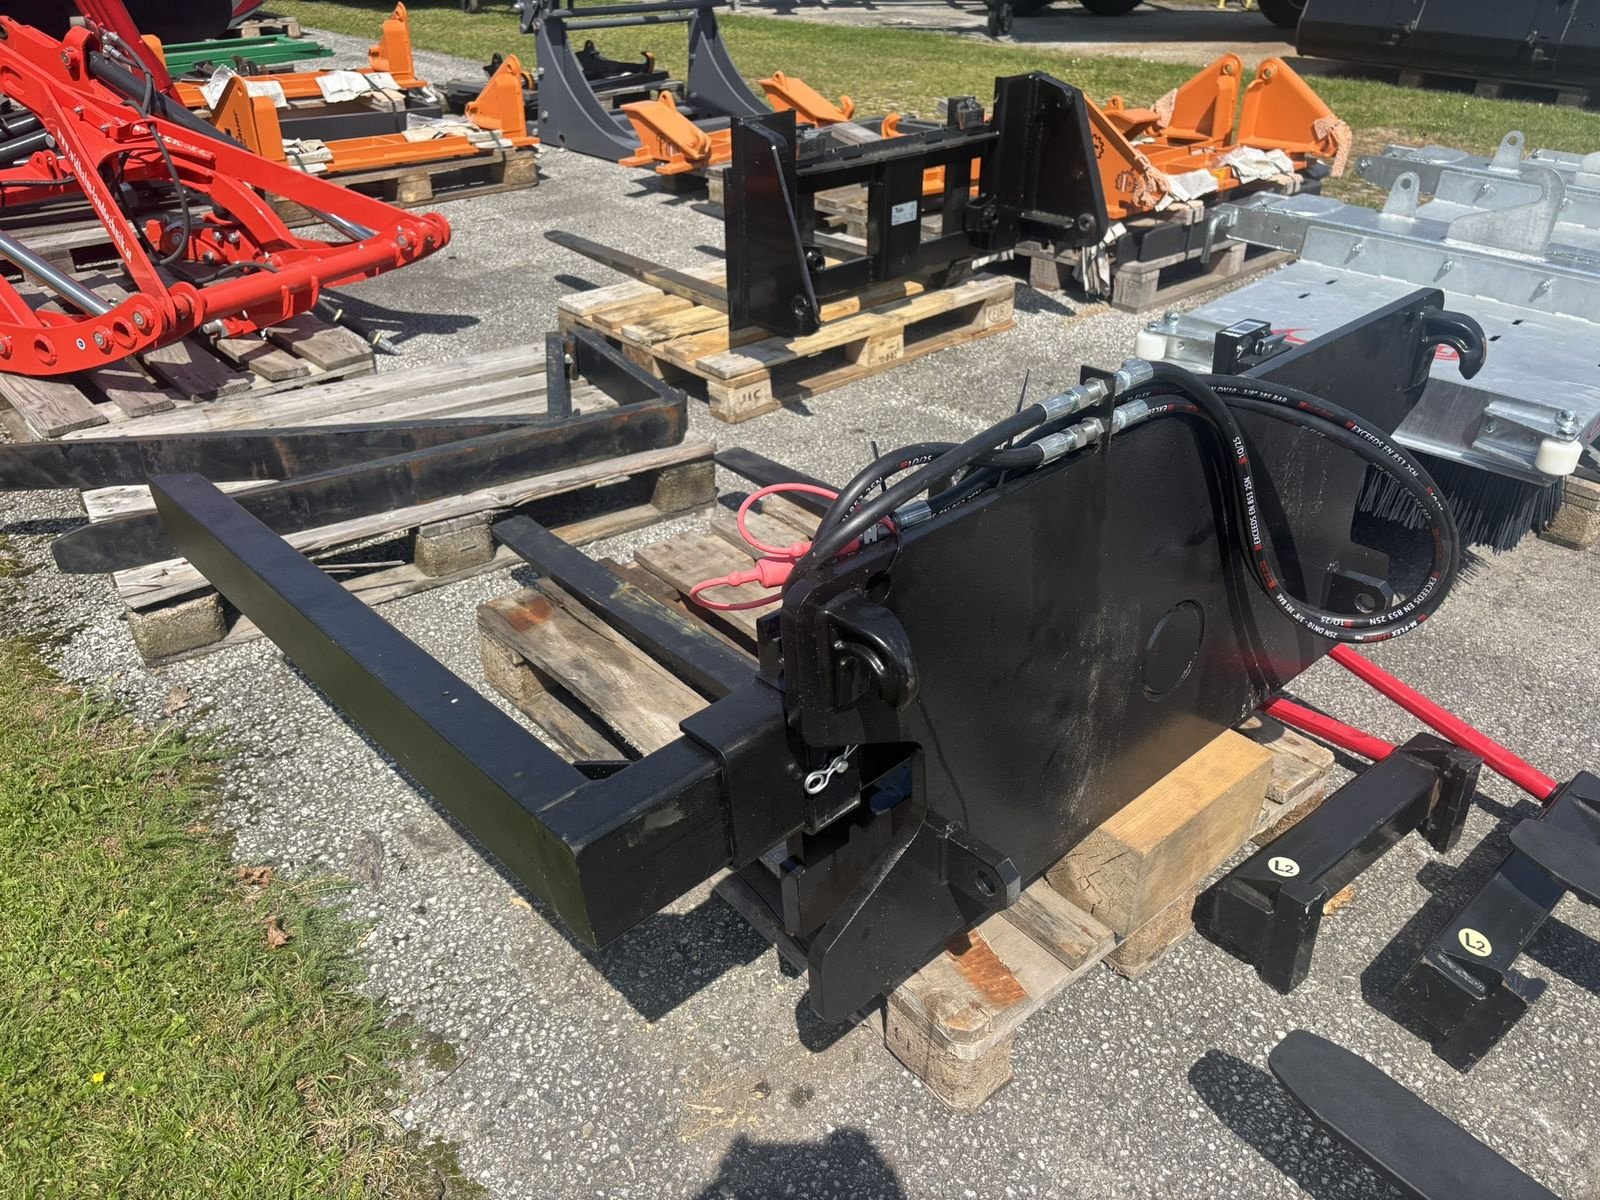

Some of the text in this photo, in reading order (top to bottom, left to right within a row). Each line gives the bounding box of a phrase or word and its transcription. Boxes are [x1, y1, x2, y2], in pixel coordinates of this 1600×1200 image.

[1232, 436, 1246, 459] 10/25
[1351, 425, 1419, 477] EXCEEDS EN 853 2SN
[1243, 476, 1261, 545] EXCEEDS EN 853 2SN
[1276, 593, 1287, 605] BAR
[1369, 576, 1437, 626] EXCEEDS EN 853 2SN
[1285, 603, 1296, 615] 385
[1306, 621, 1325, 635] DN10
[1320, 615, 1345, 627] 10/25
[1391, 619, 1418, 637] M-FLEX
[1323, 629, 1338, 639] 2SN
[1274, 859, 1295, 875] L2
[1465, 932, 1487, 954] L2
